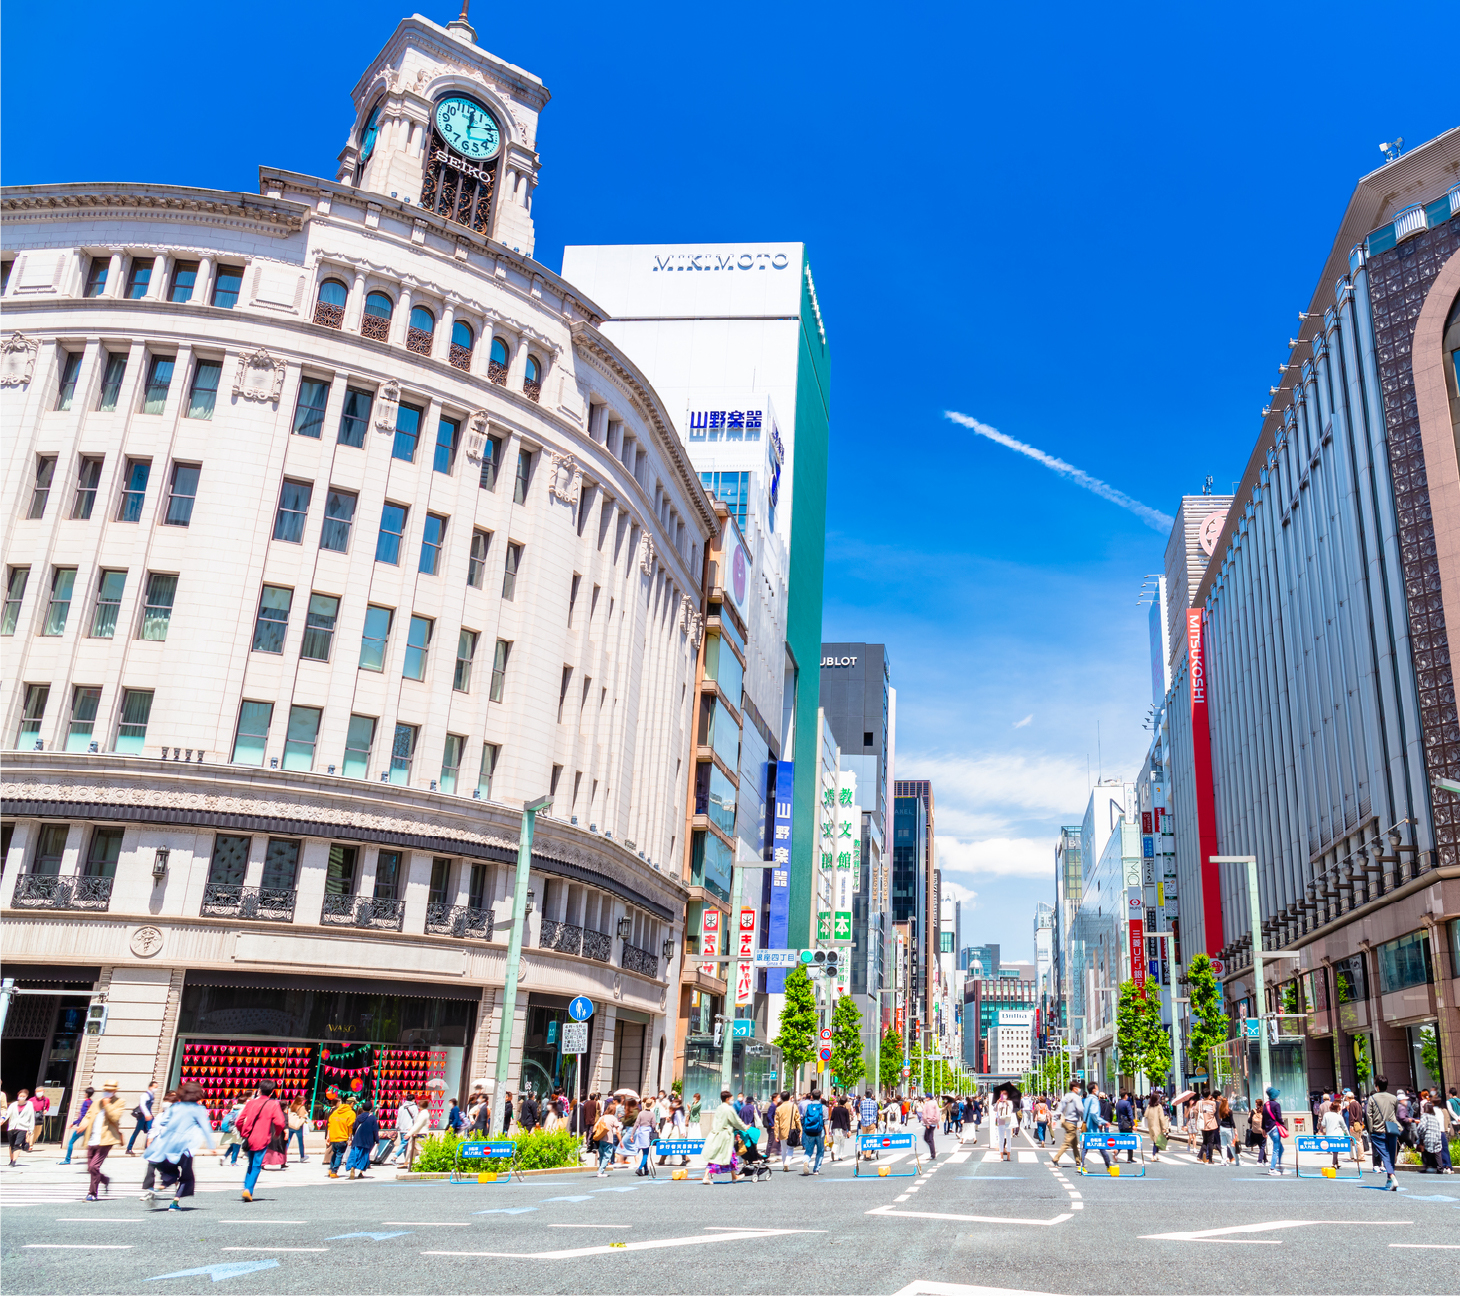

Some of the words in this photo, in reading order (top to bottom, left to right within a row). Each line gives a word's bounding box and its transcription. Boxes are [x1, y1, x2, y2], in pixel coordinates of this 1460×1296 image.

[447, 104, 456, 116] 10
[442, 112, 450, 122] 9
[444, 124, 452, 132] 8
[453, 132, 461, 142] 7
[486, 132, 494, 143] 3
[462, 140, 469, 150] 6
[471, 143, 479, 153] 5
[480, 141, 489, 150] 4
[436, 150, 490, 182] SEIKO
[653, 253, 790, 272] MIKIMOTO
[690, 410, 763, 428] 山野楽器
[1190, 614, 1204, 703] MITSUKOSHI
[837, 787, 852, 869] 教文館
[774, 802, 791, 887] 山野楽器
[836, 916, 849, 935] 本
[1133, 930, 1143, 988] 三菱UFJ銀行
[328, 1024, 356, 1033] WAKO
[326, 1066, 370, 1076] FUMIKO
